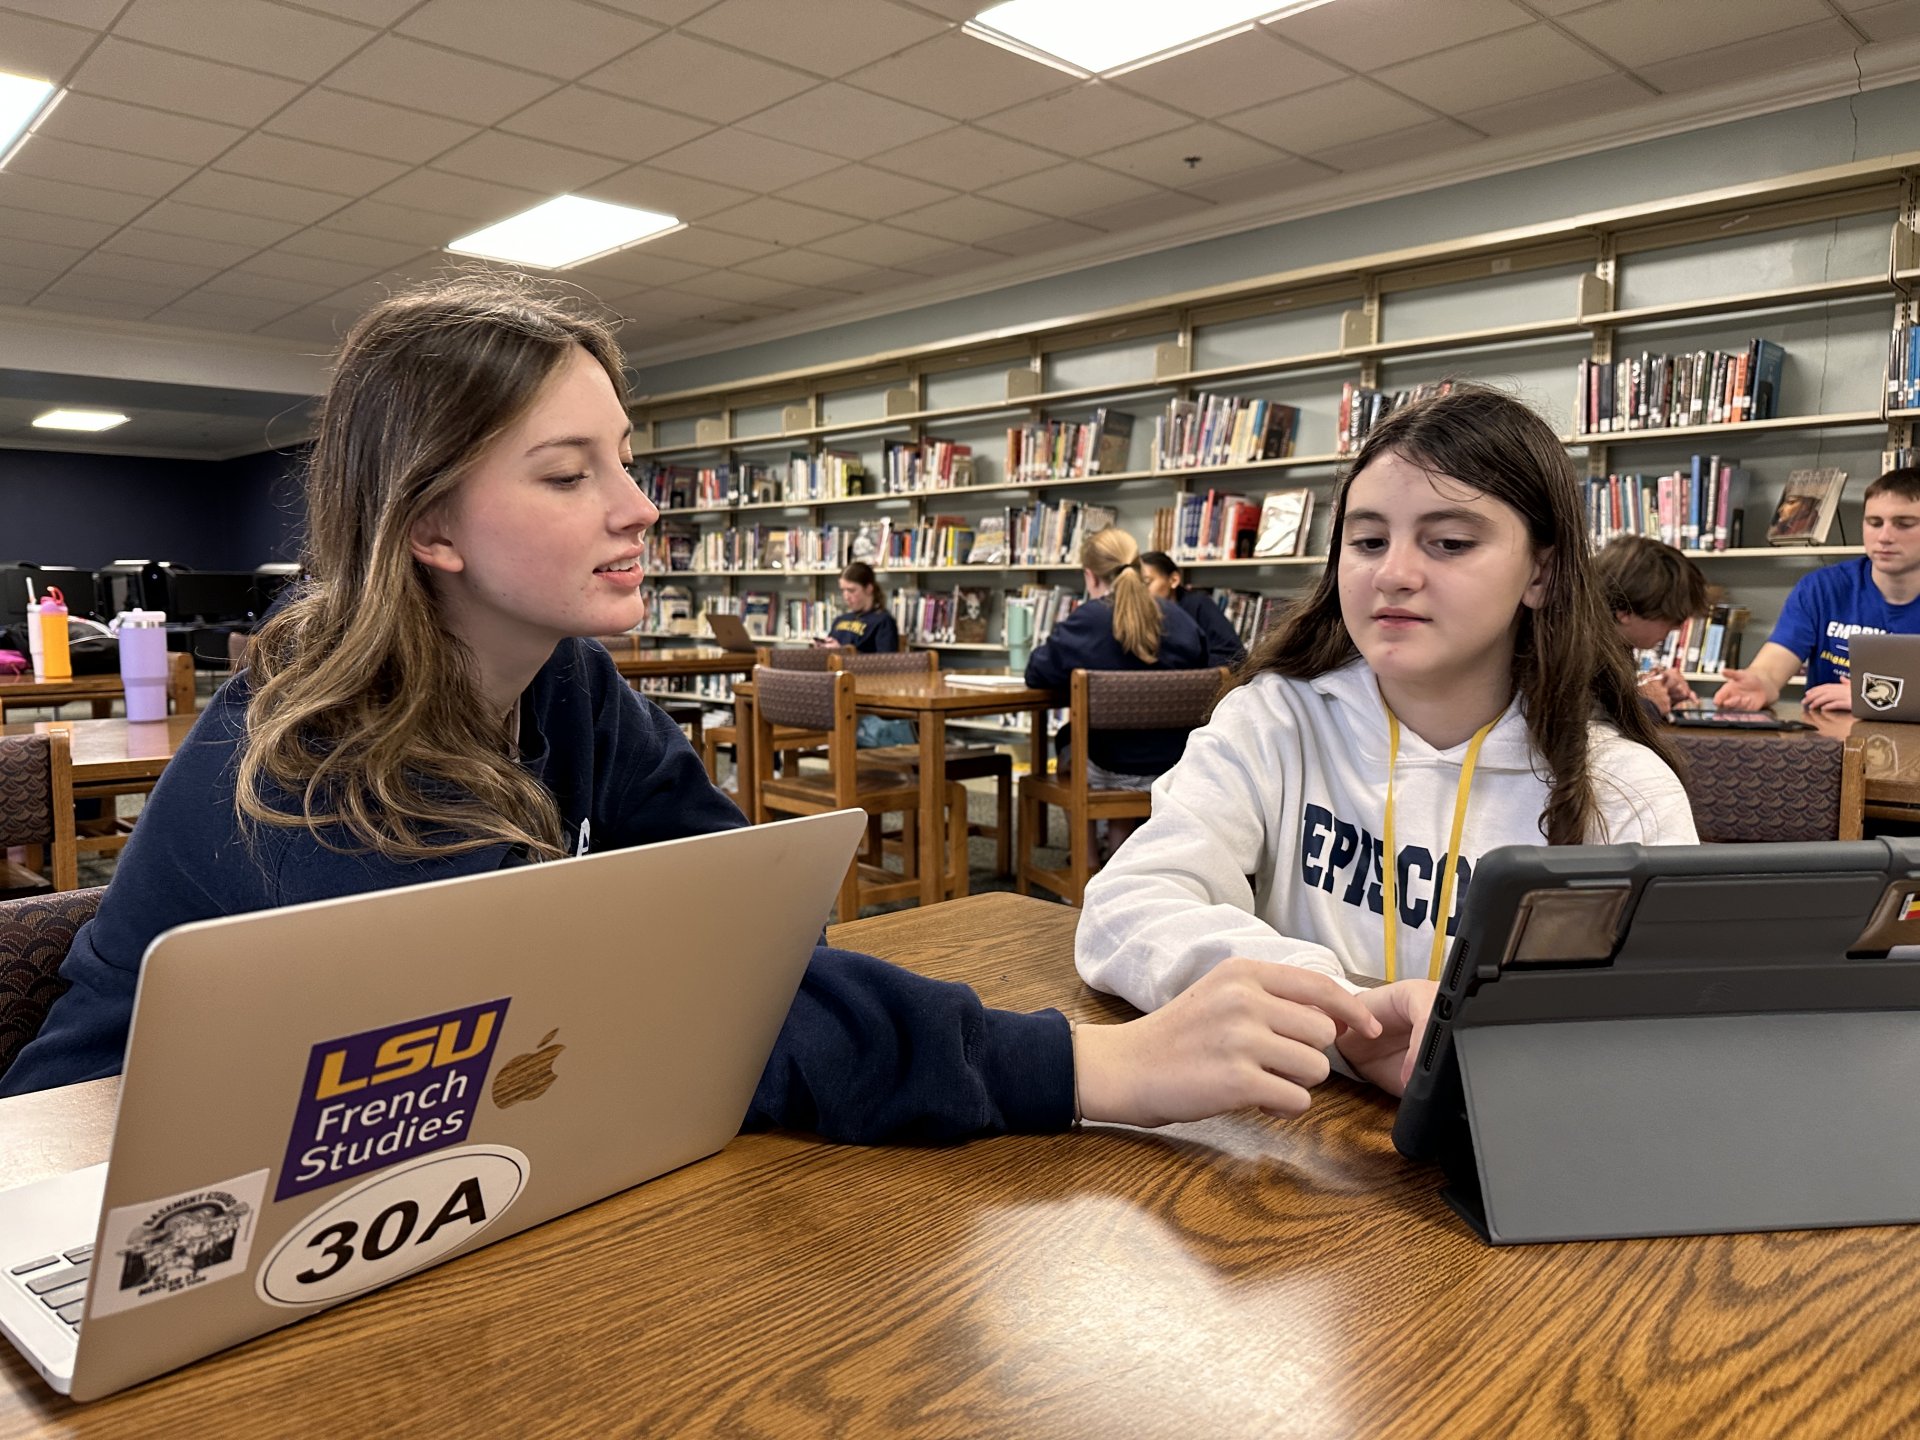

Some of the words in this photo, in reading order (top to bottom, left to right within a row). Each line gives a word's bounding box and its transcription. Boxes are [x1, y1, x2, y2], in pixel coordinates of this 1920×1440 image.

[1302, 803, 1480, 936] EPISCO
[315, 1011, 497, 1100] LSU
[295, 1109, 465, 1181] Studies
[315, 1069, 468, 1141] French
[296, 1177, 486, 1284] 30A
